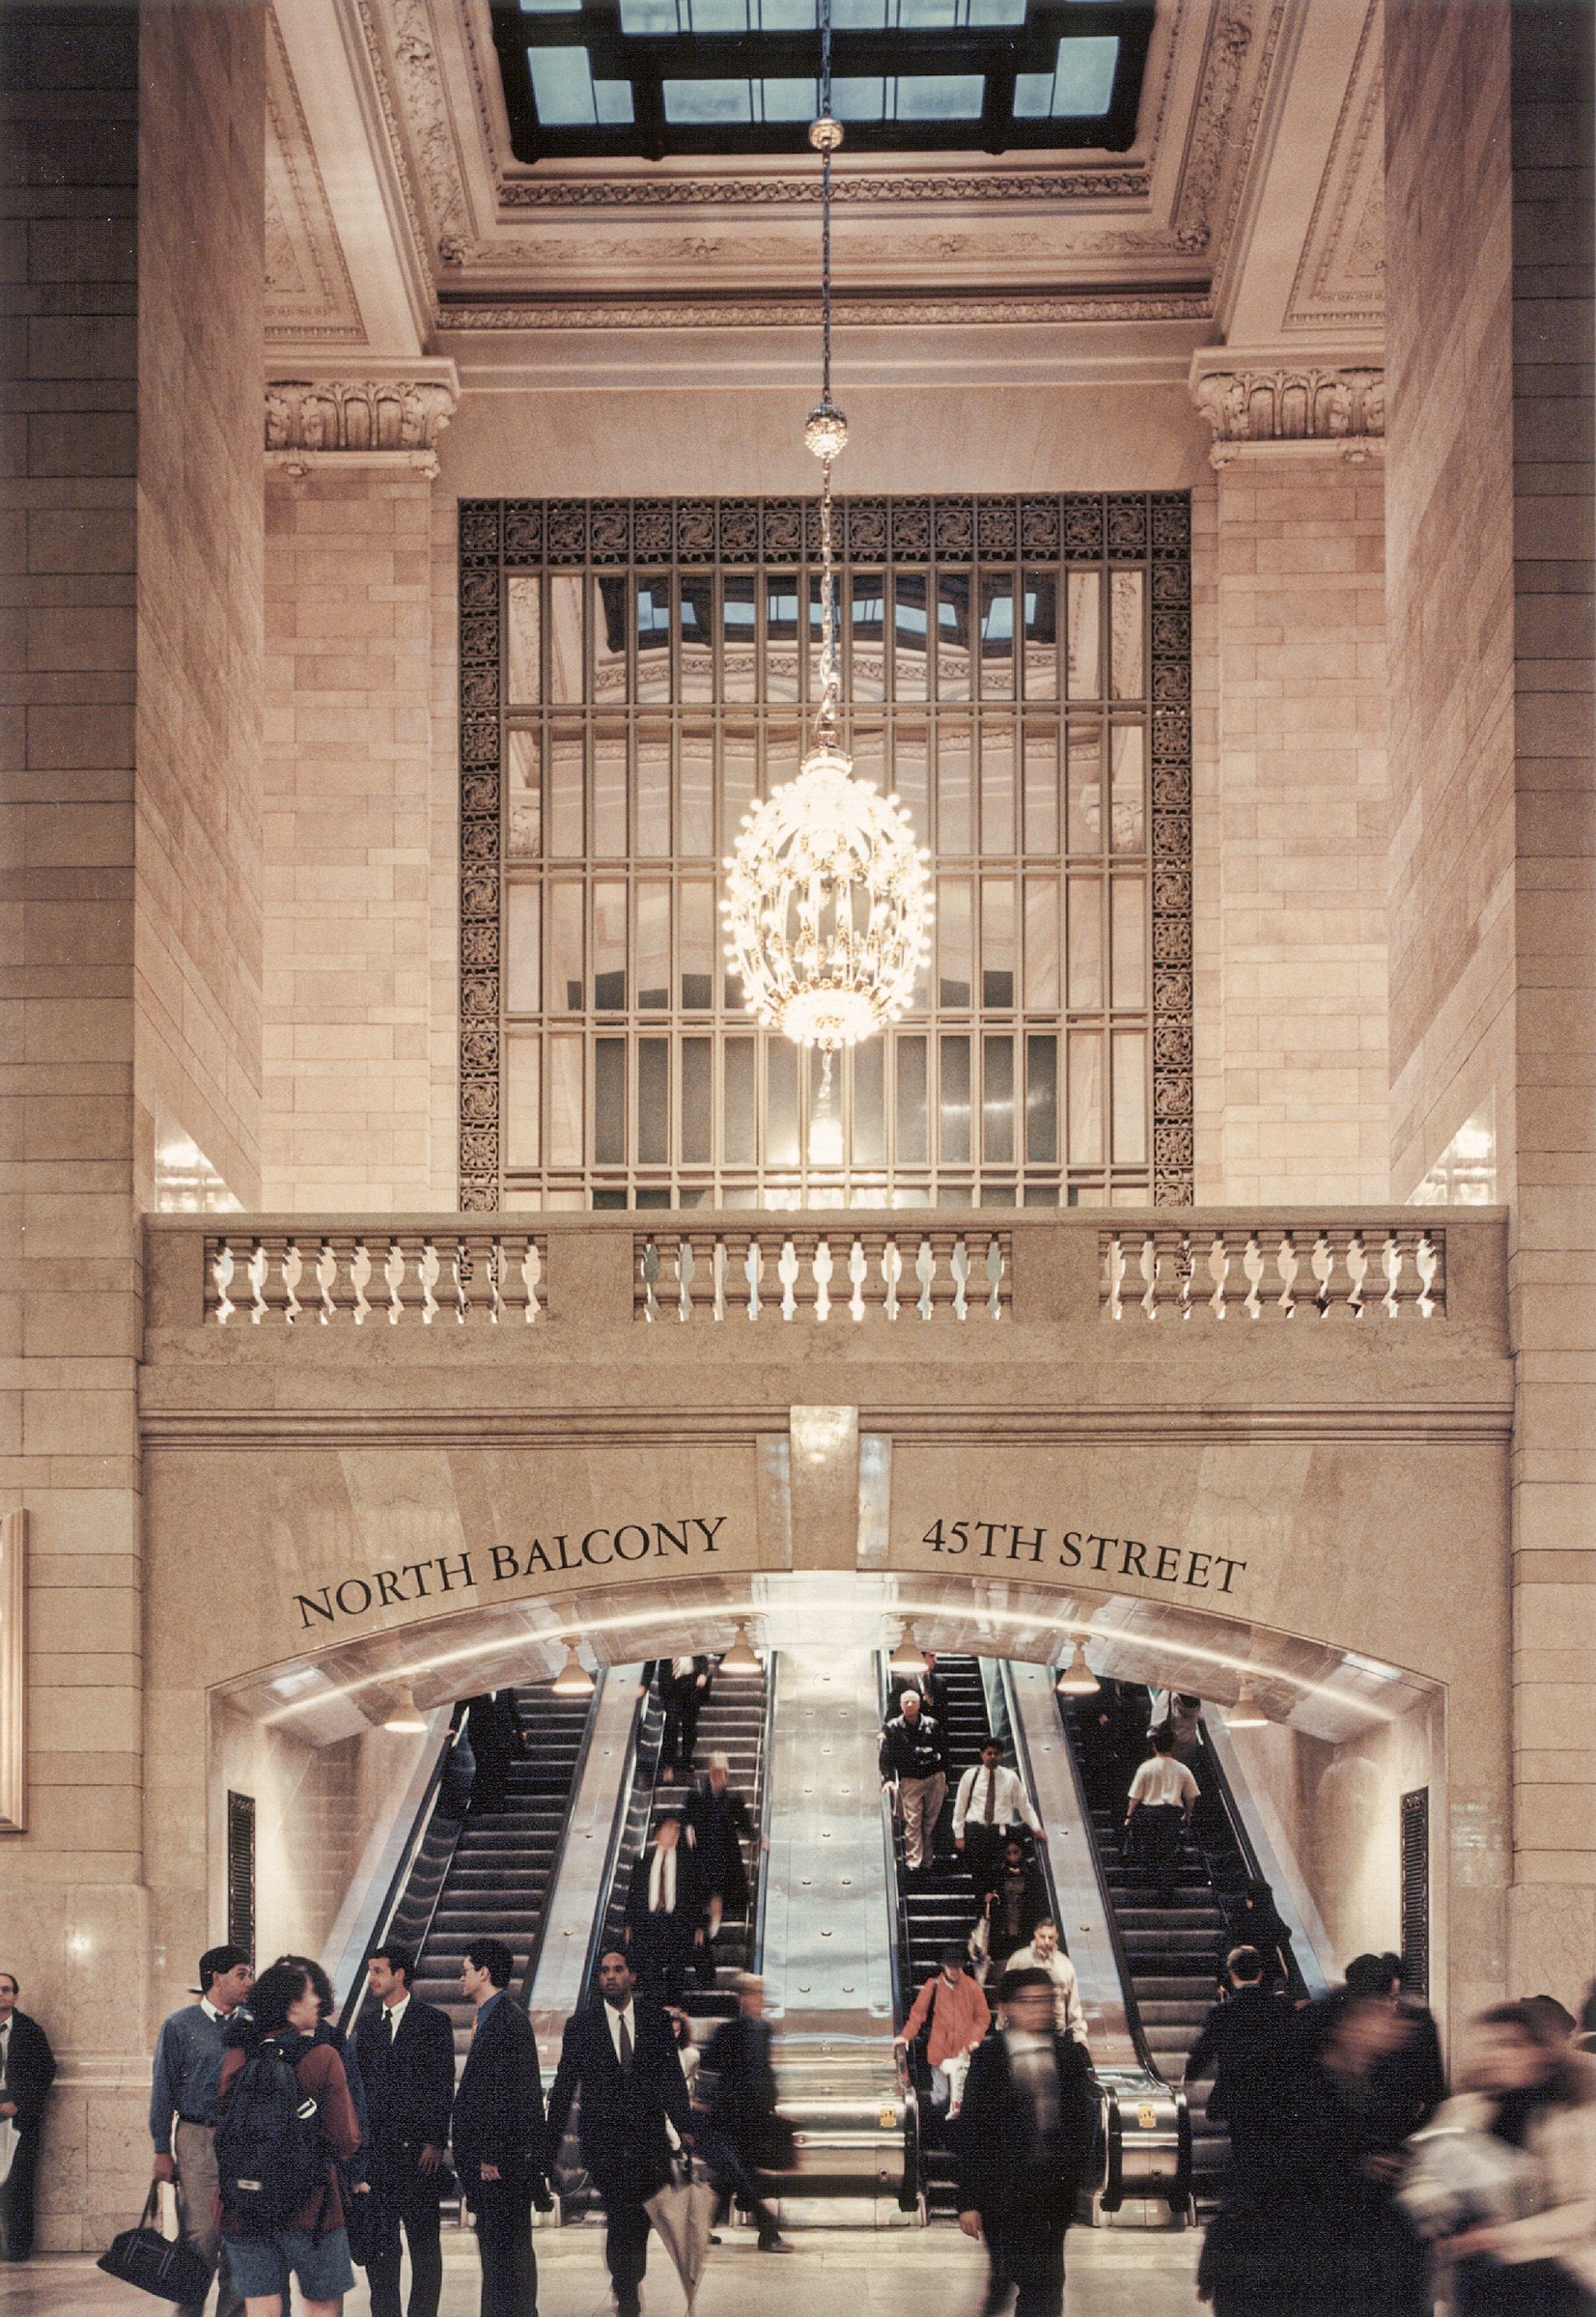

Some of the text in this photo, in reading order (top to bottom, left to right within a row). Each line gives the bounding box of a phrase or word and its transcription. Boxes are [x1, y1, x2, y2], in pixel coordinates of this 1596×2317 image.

[292, 1516, 728, 1629] NORTH BALCONY
[922, 1519, 1247, 1595] 45TH STREET
